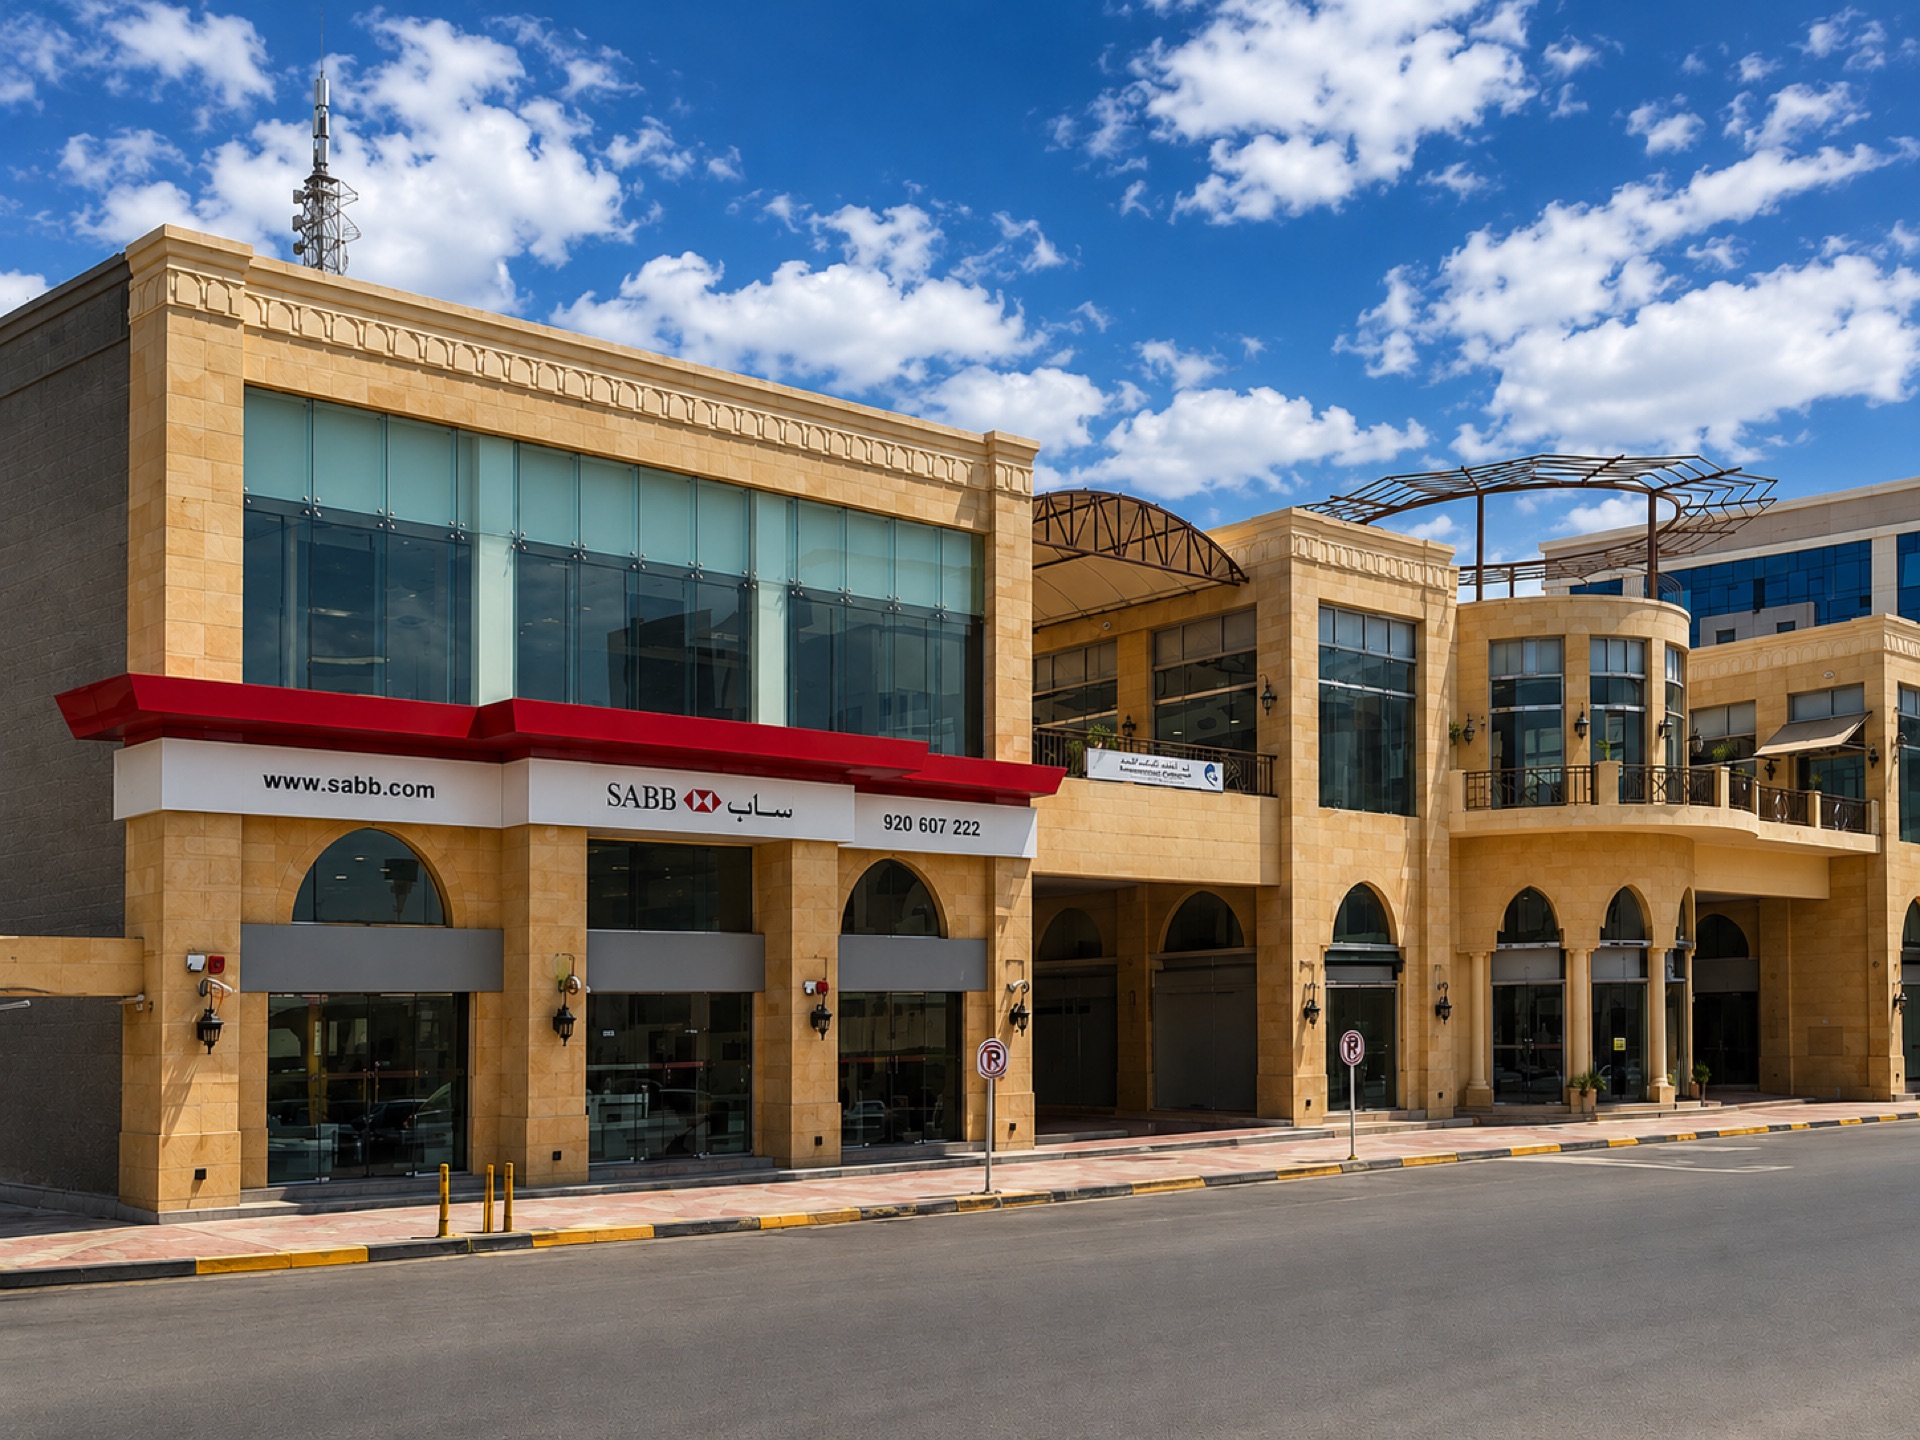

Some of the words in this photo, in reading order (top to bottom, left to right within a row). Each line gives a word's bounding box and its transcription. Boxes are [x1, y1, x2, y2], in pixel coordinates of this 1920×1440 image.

[262, 773, 435, 800] www.sabb.com
[606, 782, 677, 811] SABB
[726, 793, 793, 823] ساب
[883, 813, 913, 832] 920
[918, 816, 948, 834] 607
[952, 818, 981, 837] 222
